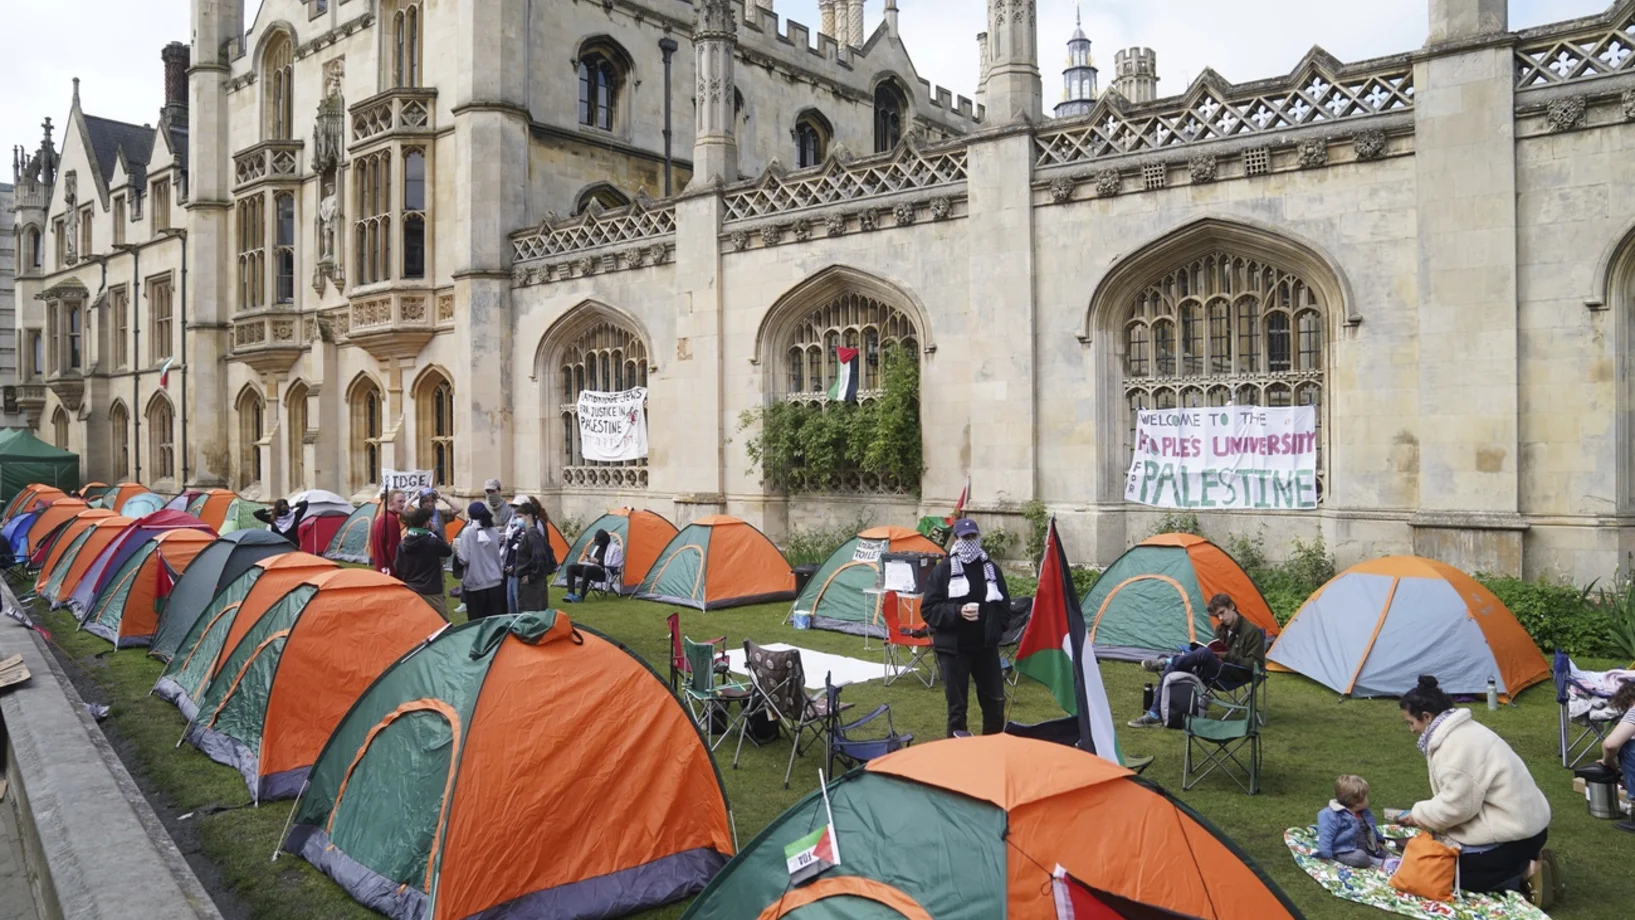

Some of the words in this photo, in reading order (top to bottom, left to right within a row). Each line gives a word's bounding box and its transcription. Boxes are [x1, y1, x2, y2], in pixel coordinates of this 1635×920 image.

[591, 406, 617, 417] JUSTICE
[618, 406, 626, 417] IN
[1140, 412, 1201, 427] WELCOME
[1208, 412, 1230, 427] TO
[1240, 411, 1267, 427] THE
[581, 416, 622, 435] PALESTINE
[1212, 430, 1317, 457] UNIVERSITY
[1139, 460, 1316, 509] PALESTINE
[855, 549, 881, 560] TOILET
